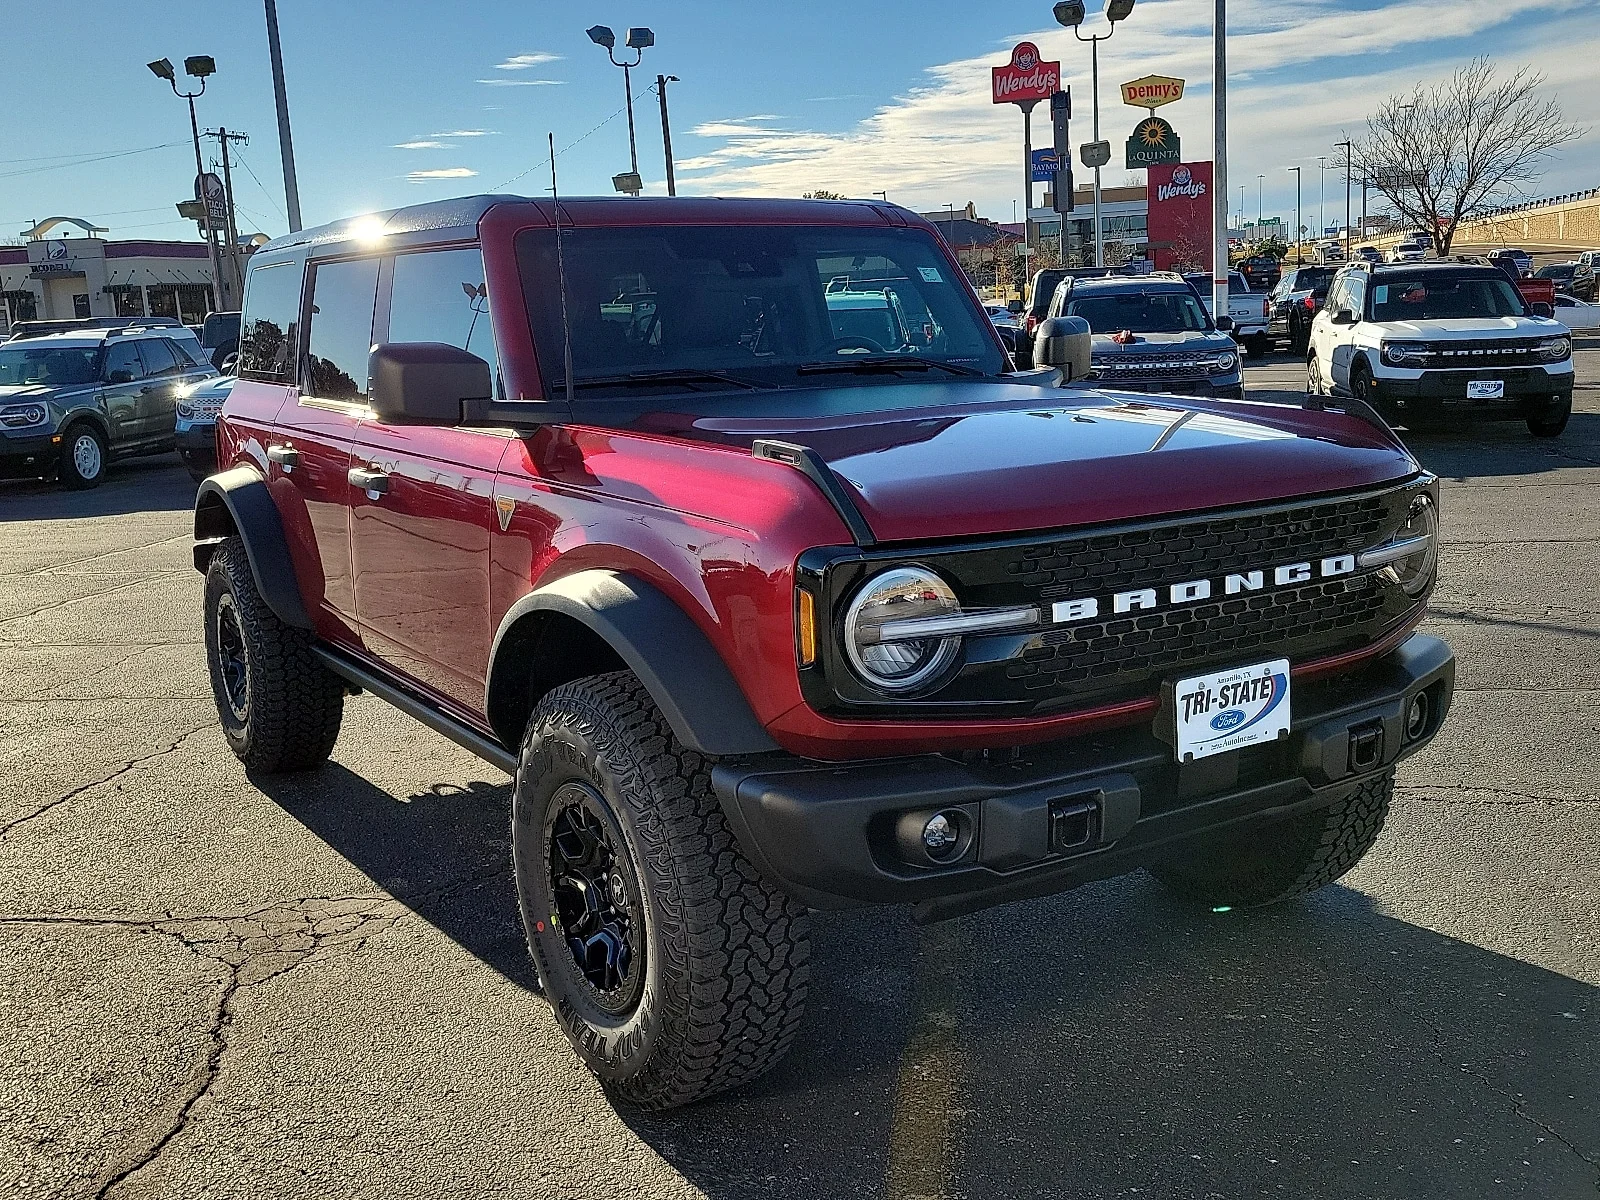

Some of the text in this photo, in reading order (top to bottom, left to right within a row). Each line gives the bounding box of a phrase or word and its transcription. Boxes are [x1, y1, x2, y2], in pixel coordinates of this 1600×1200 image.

[995, 67, 1057, 97] Wendy's
[1127, 82, 1180, 101] Denny's
[1136, 150, 1180, 162] QUINTA
[1158, 179, 1206, 201] Wendy's
[207, 199, 224, 210] TACO
[209, 208, 225, 218] BELL
[1052, 554, 1355, 623] BRONCO
[1242, 670, 1252, 679] TX
[1180, 675, 1272, 725] TRI-STATE
[1217, 711, 1239, 728] Ford
